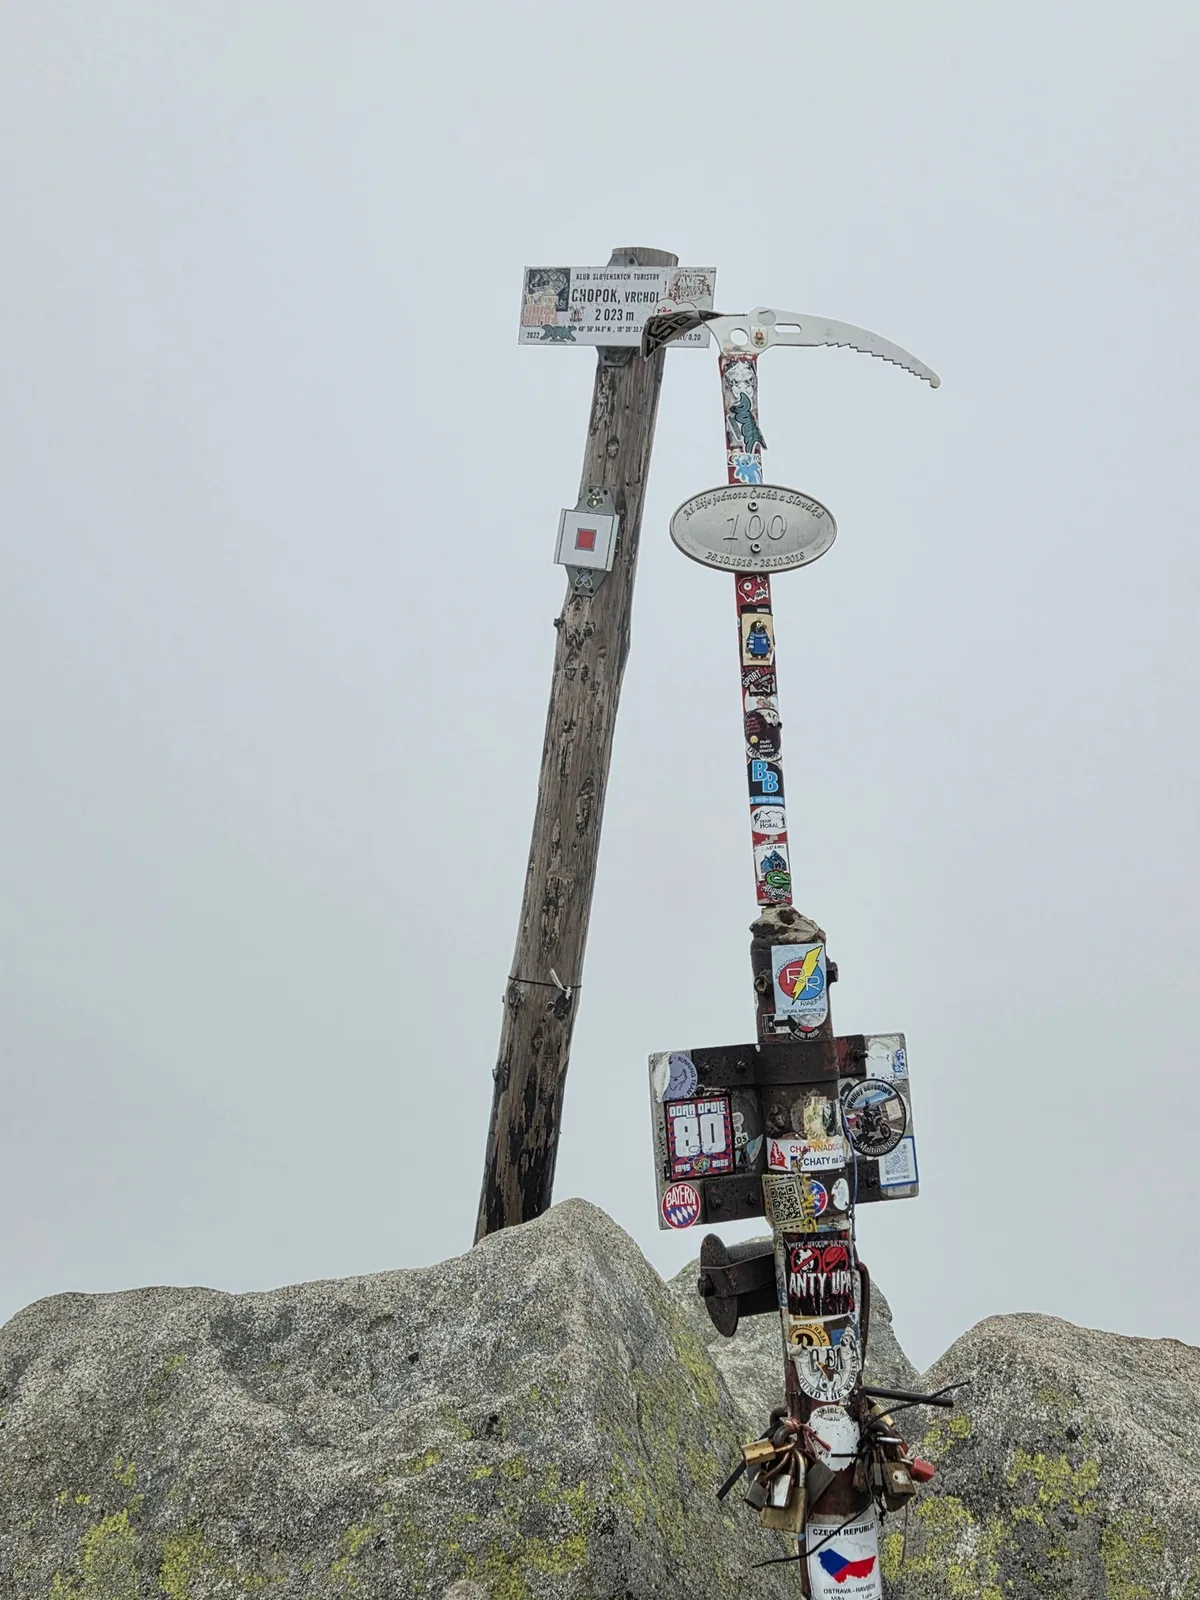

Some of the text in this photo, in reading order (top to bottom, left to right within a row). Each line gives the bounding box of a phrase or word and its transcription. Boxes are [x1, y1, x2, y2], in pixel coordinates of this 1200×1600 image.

[572, 288, 620, 304] CHOPOK,
[626, 311, 634, 321] m
[526, 331, 540, 340] 2022
[713, 490, 748, 506] jednota
[722, 514, 788, 541] 100
[704, 551, 752, 568] 28.10.1918
[760, 551, 806, 568] 28.10.2018
[669, 1101, 726, 1118] ODRA OPOLE
[674, 1114, 726, 1158] 80
[674, 1159, 729, 1172] 1945 2025
[804, 1156, 831, 1166] CHATY
[666, 1184, 696, 1208] BAYERN
[789, 1272, 827, 1298] ANTY
[832, 1270, 852, 1295] UPA
[844, 1522, 874, 1536] REPUBLIC
